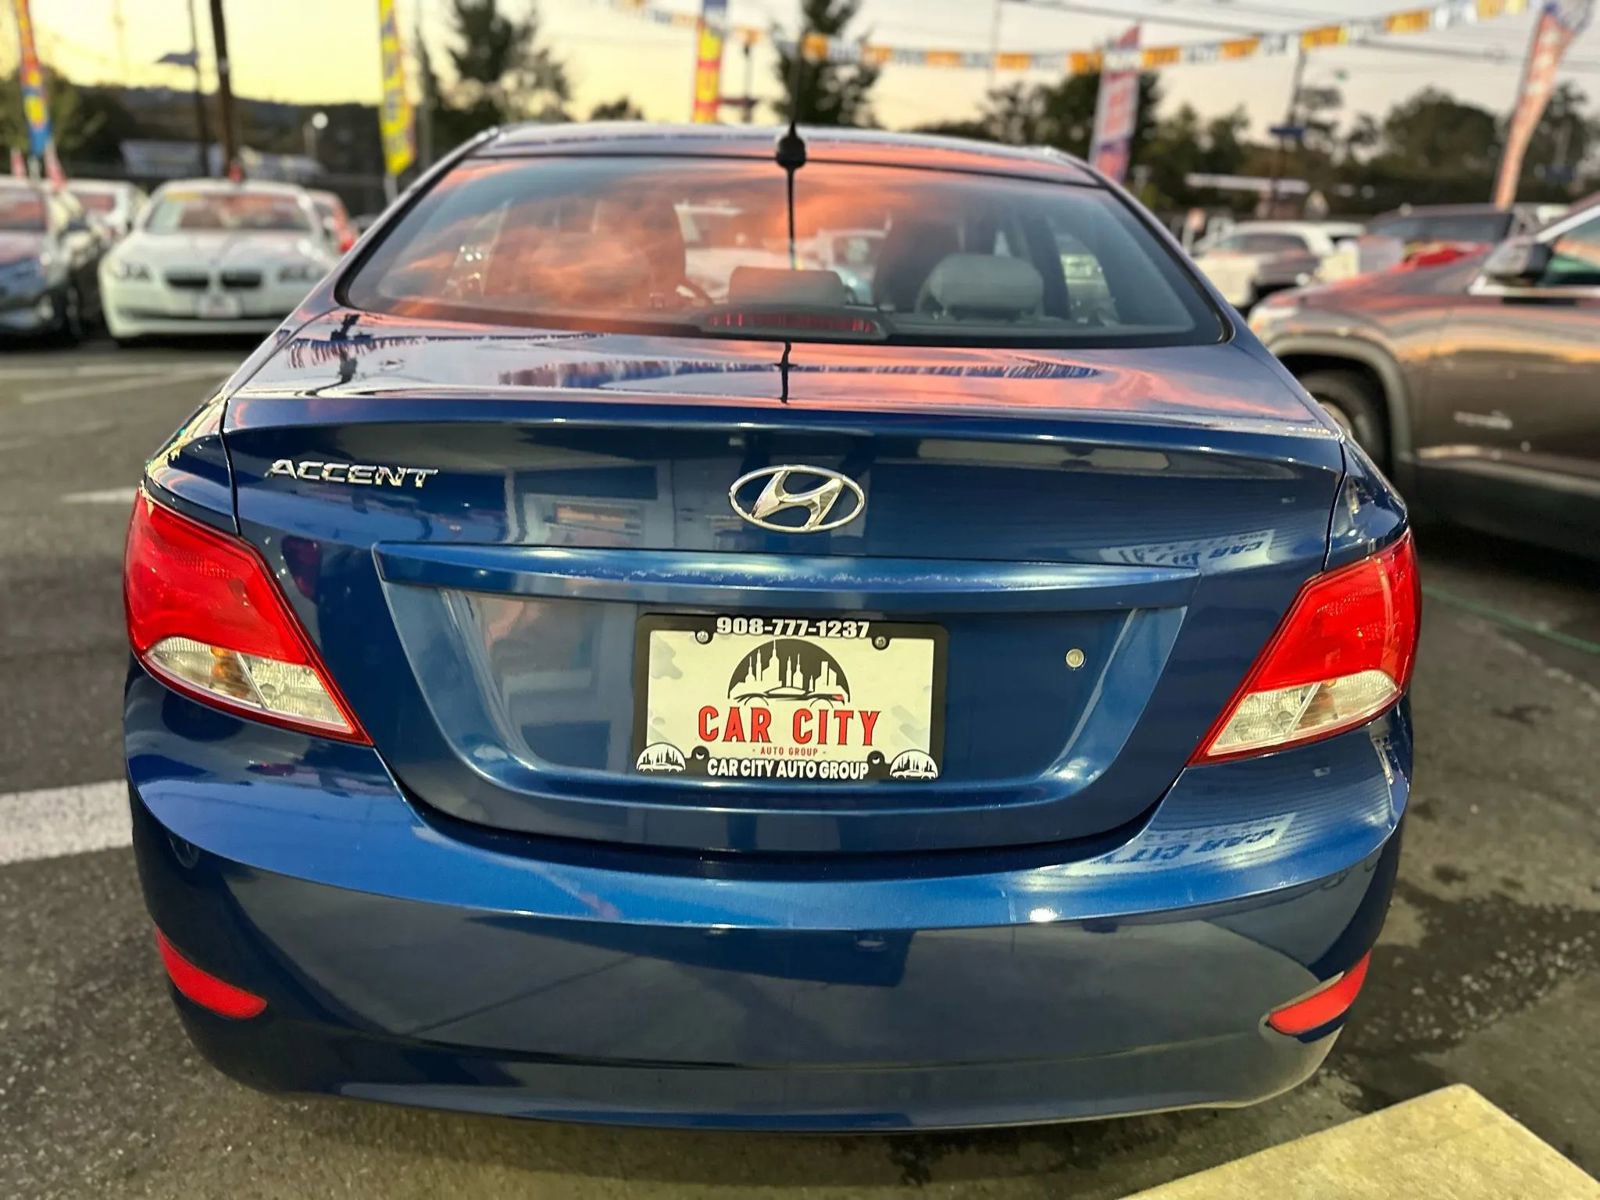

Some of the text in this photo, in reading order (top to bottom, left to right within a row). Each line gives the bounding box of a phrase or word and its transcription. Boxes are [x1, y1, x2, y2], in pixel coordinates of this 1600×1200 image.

[264, 459, 439, 488] ACCENT
[716, 617, 870, 639] 908-777-1237
[698, 705, 881, 747] CAR CITY
[760, 747, 818, 757] AUTO GROUP
[707, 758, 869, 780] CAR CITY AUTO GROUP
